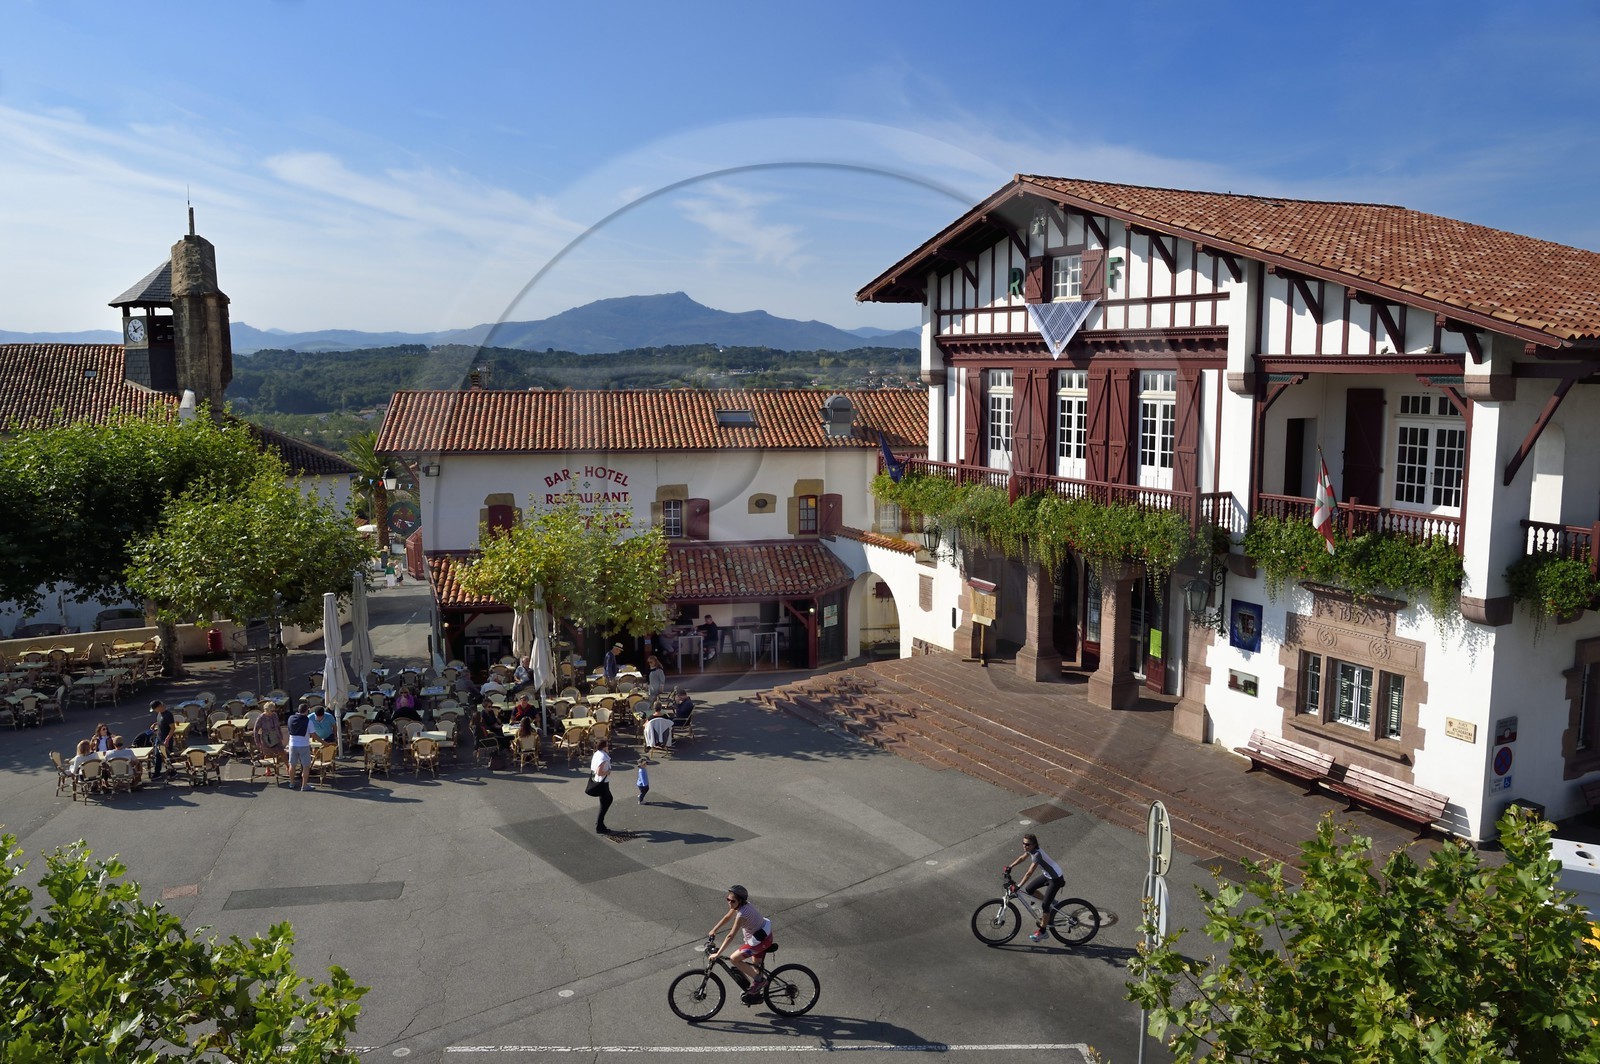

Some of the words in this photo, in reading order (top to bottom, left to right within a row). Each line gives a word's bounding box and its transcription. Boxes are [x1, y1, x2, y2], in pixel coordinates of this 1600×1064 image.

[1106, 257, 1123, 291] F
[544, 469, 571, 487] BAR
[585, 466, 628, 487] HOTEL
